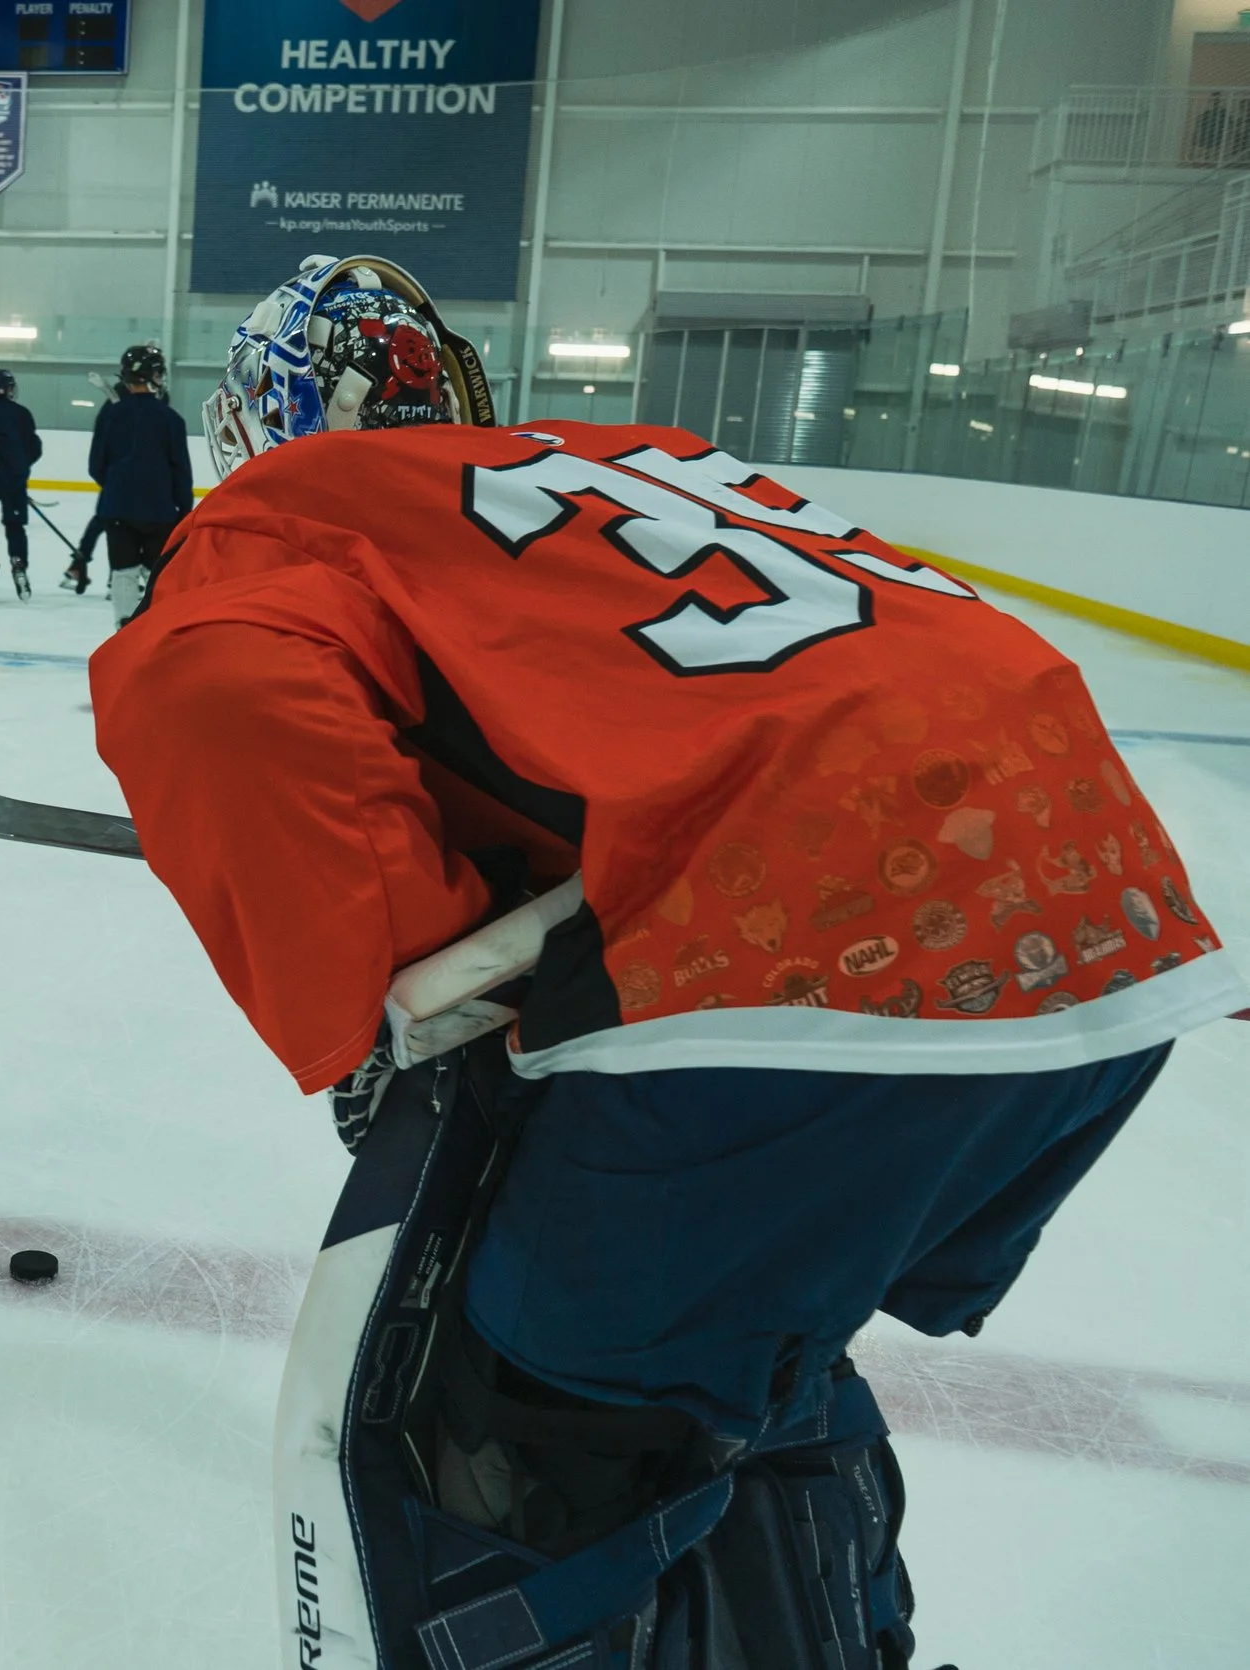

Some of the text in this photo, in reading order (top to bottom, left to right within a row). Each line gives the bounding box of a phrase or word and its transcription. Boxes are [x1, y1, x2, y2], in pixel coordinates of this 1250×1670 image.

[16, 3, 54, 15] PLAYER
[69, 3, 113, 15] PENALTY
[280, 39, 457, 70] HEALTHY
[233, 82, 497, 114] COMPETITION
[284, 191, 465, 211] KAISER PERMANENTE
[459, 346, 491, 424] WARWICK
[673, 950, 730, 988] BULLS
[763, 956, 820, 989] COLORADO
[843, 940, 896, 973] NAHL
